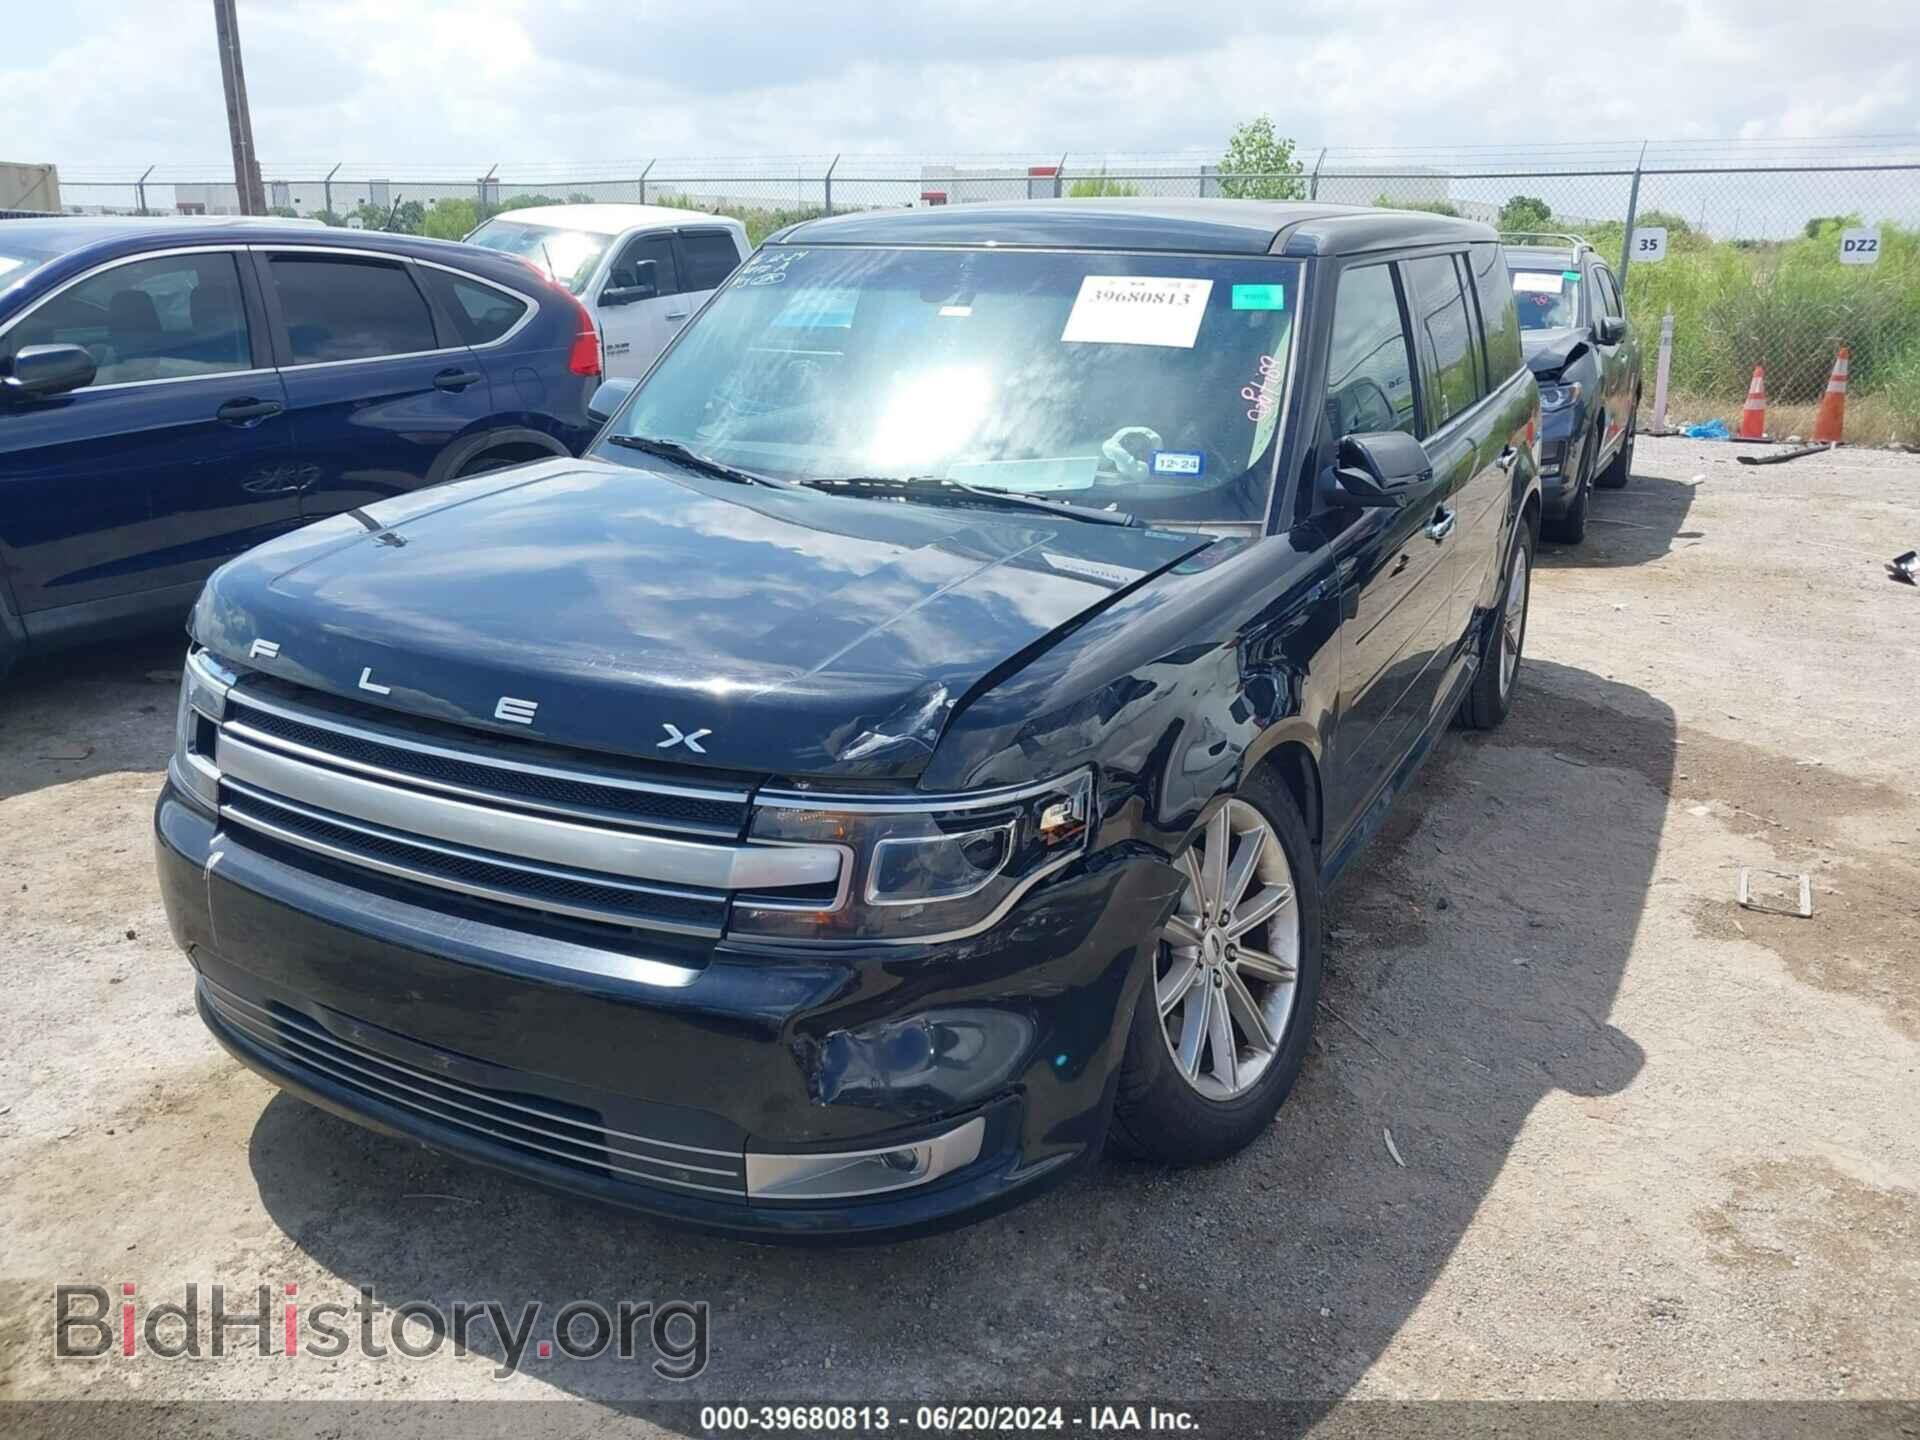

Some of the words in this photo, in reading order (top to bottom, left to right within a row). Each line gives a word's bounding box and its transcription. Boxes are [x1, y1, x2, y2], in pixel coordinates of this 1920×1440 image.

[1639, 239, 1658, 251] 35
[1844, 239, 1878, 252] DZ2
[1089, 289, 1192, 306] 39680813
[249, 637, 713, 753] FLEX
